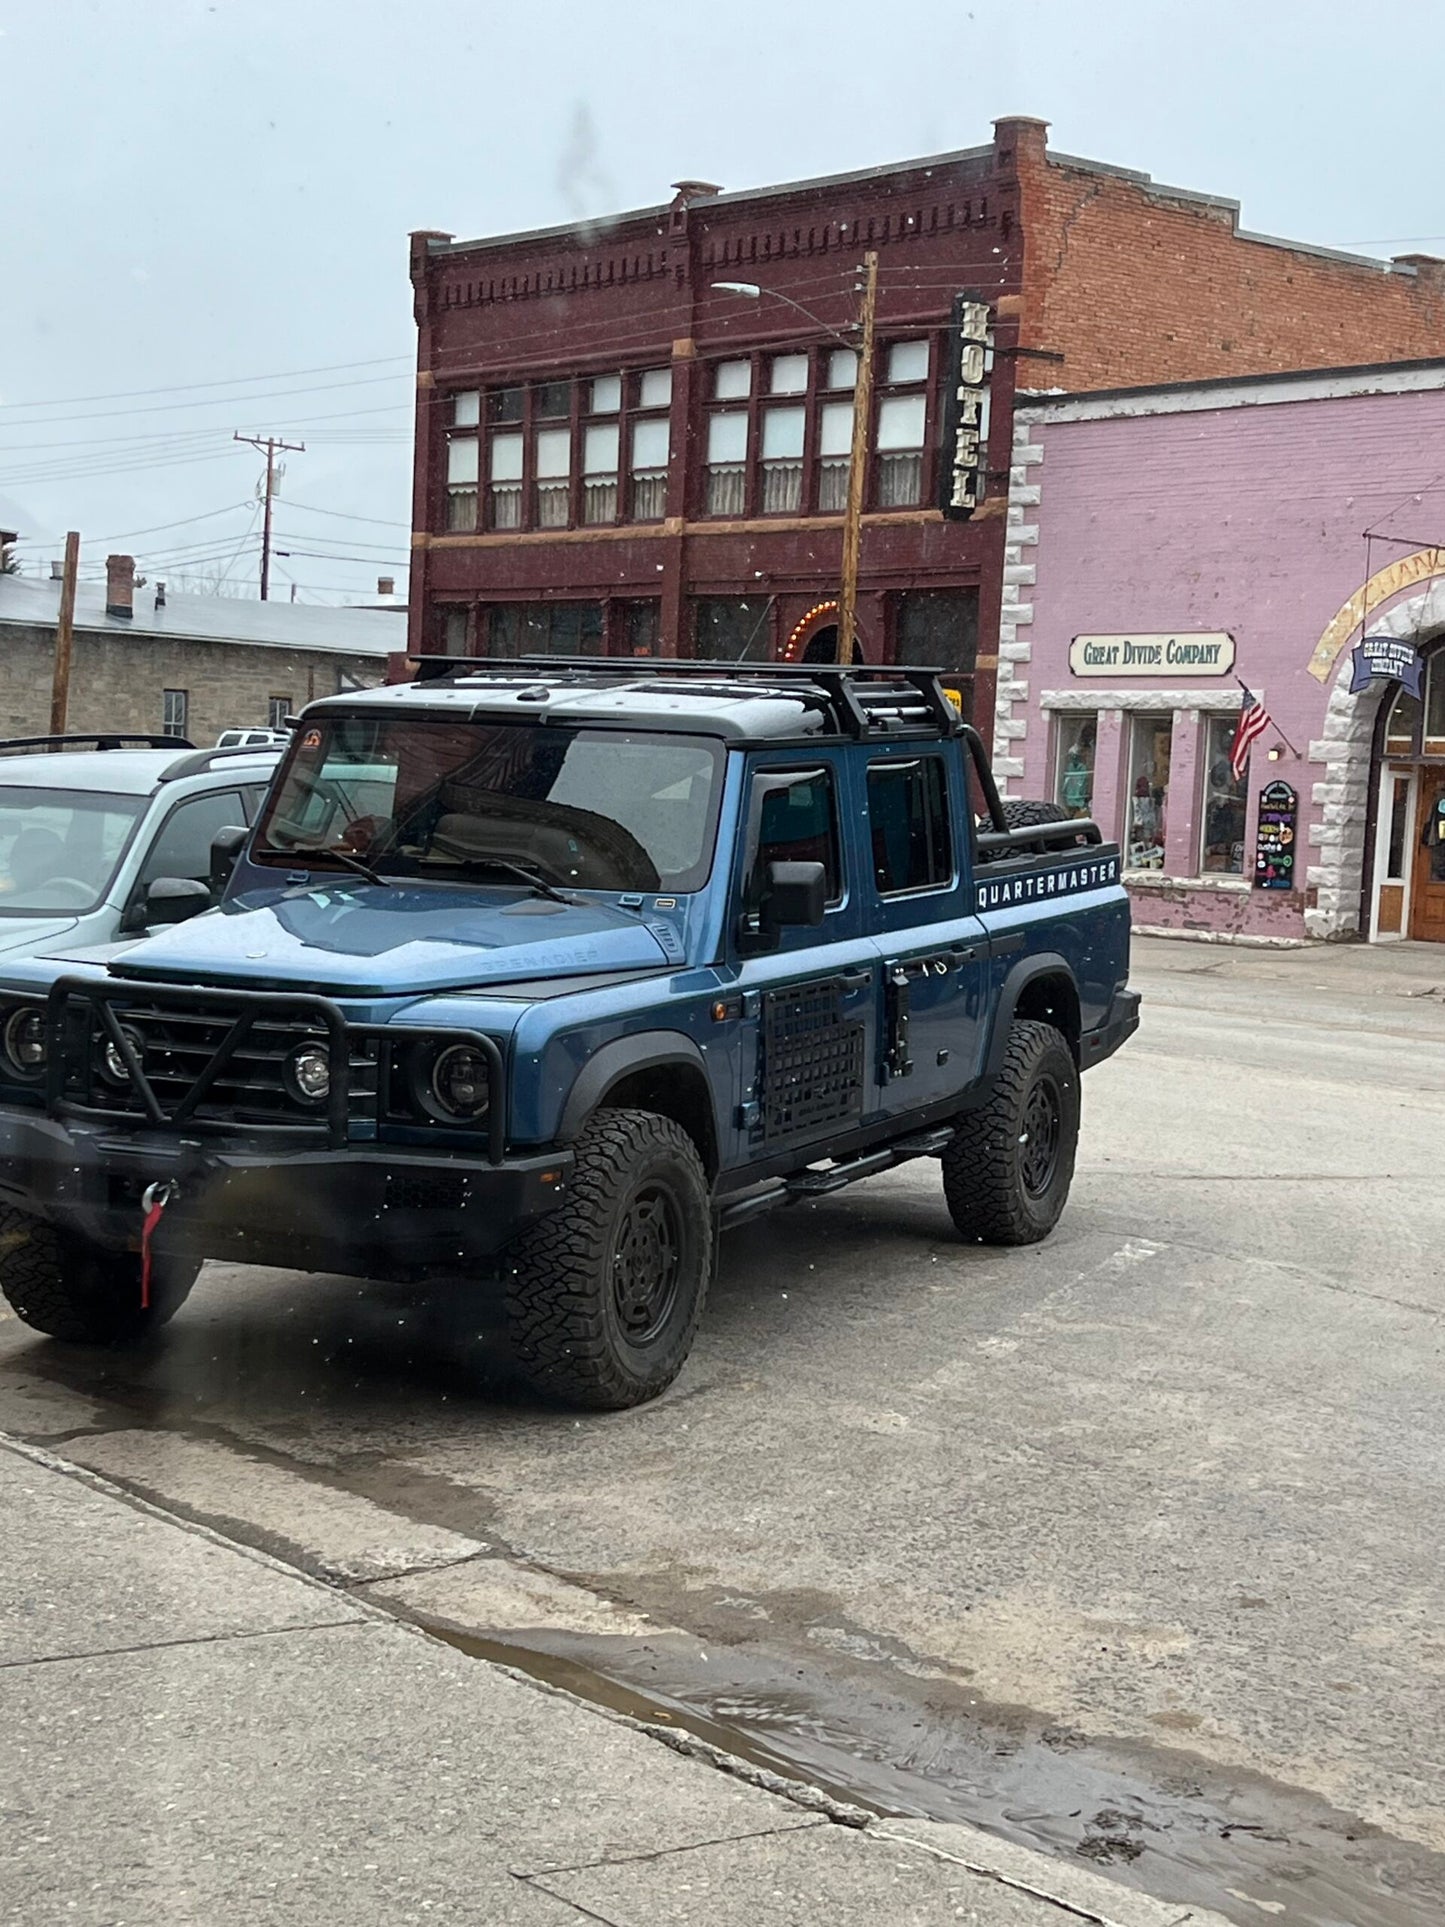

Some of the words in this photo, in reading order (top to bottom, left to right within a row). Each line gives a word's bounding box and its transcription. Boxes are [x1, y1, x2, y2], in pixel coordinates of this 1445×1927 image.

[950, 301, 991, 509] HOTEL
[1083, 642, 1119, 666] GREAT
[1122, 640, 1163, 665] DIVIDE
[1166, 639, 1222, 665] COMPANY
[978, 860, 1116, 908] QUARTERMASTER
